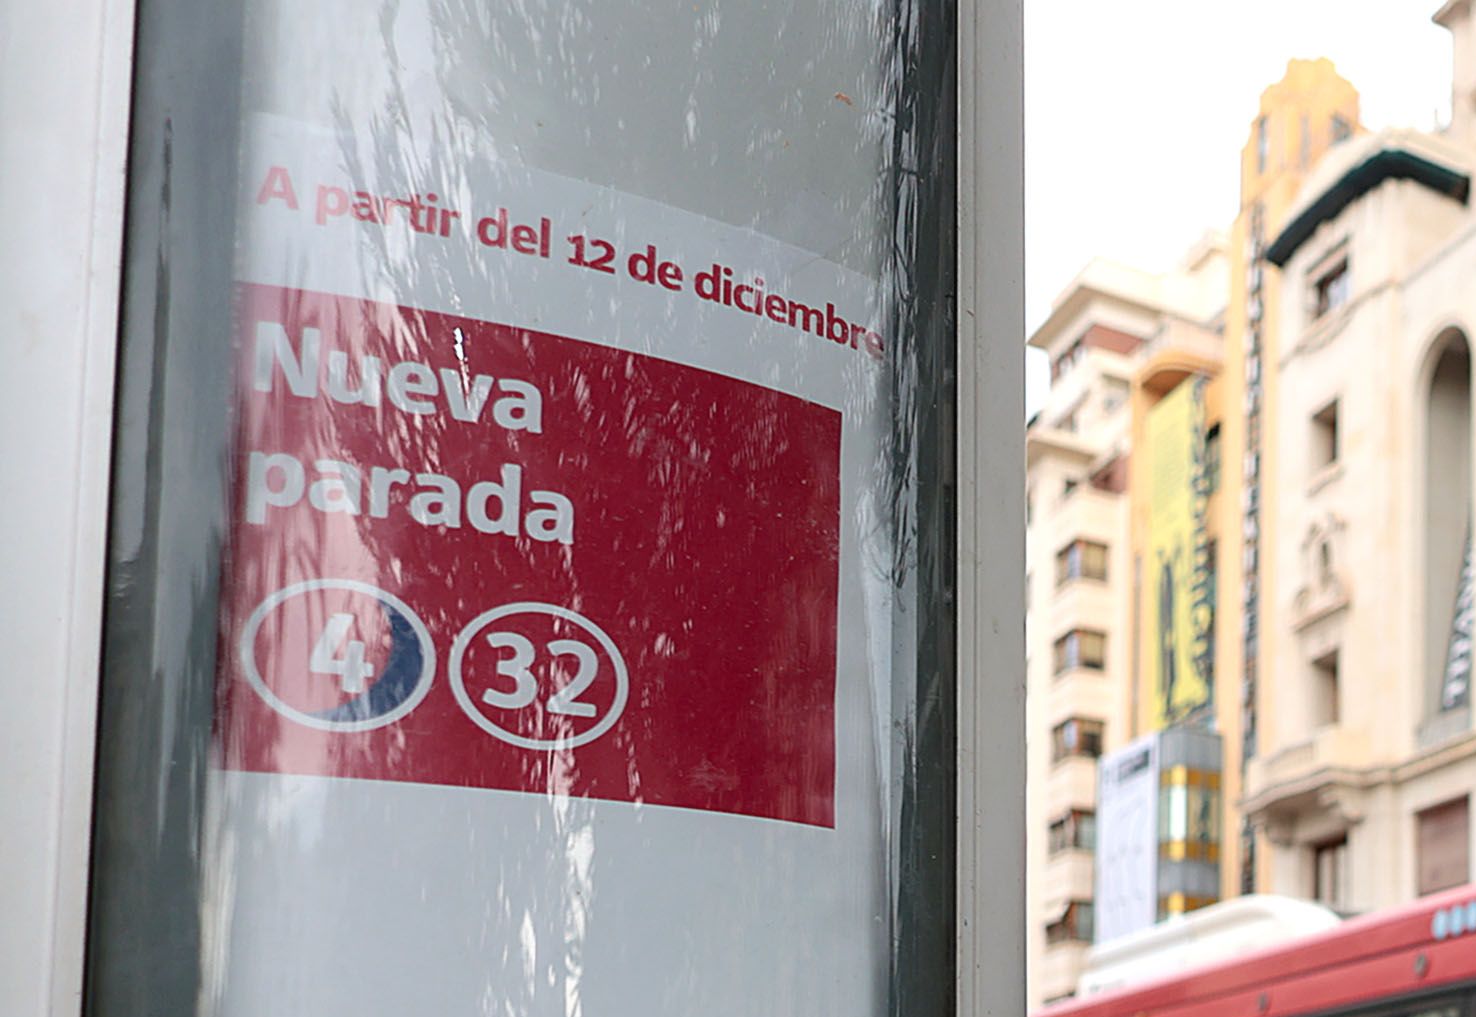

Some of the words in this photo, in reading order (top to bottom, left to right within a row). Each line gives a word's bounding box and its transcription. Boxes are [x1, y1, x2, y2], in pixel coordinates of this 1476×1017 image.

[256, 167, 299, 211] A
[313, 183, 460, 238] partir
[478, 207, 551, 257] del
[567, 235, 616, 274] 12
[628, 247, 683, 292] de
[695, 264, 885, 359] diciembre
[253, 322, 544, 434] Nueva
[245, 448, 575, 545] parada
[310, 614, 374, 693] 4
[482, 632, 598, 718] 32
